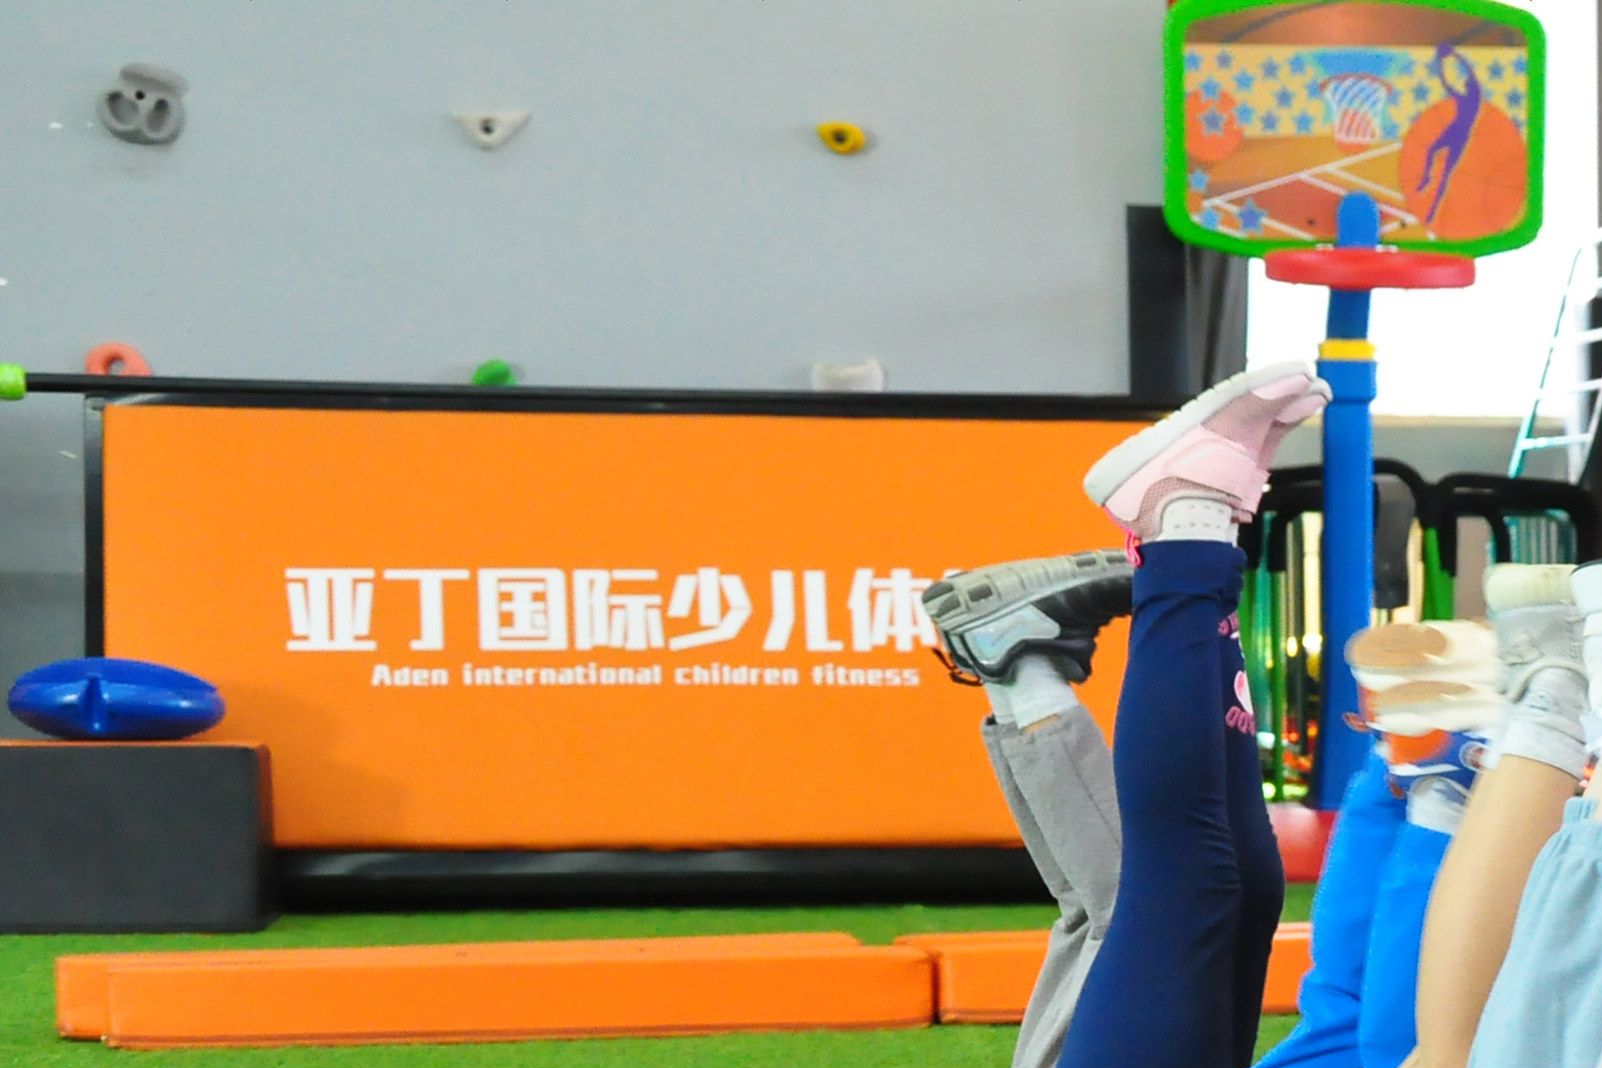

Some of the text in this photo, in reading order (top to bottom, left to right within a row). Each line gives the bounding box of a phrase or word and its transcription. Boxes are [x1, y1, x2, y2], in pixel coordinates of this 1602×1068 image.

[285, 567, 962, 652] 亚丁国际少儿体
[372, 662, 920, 686] Aden international children fitness
